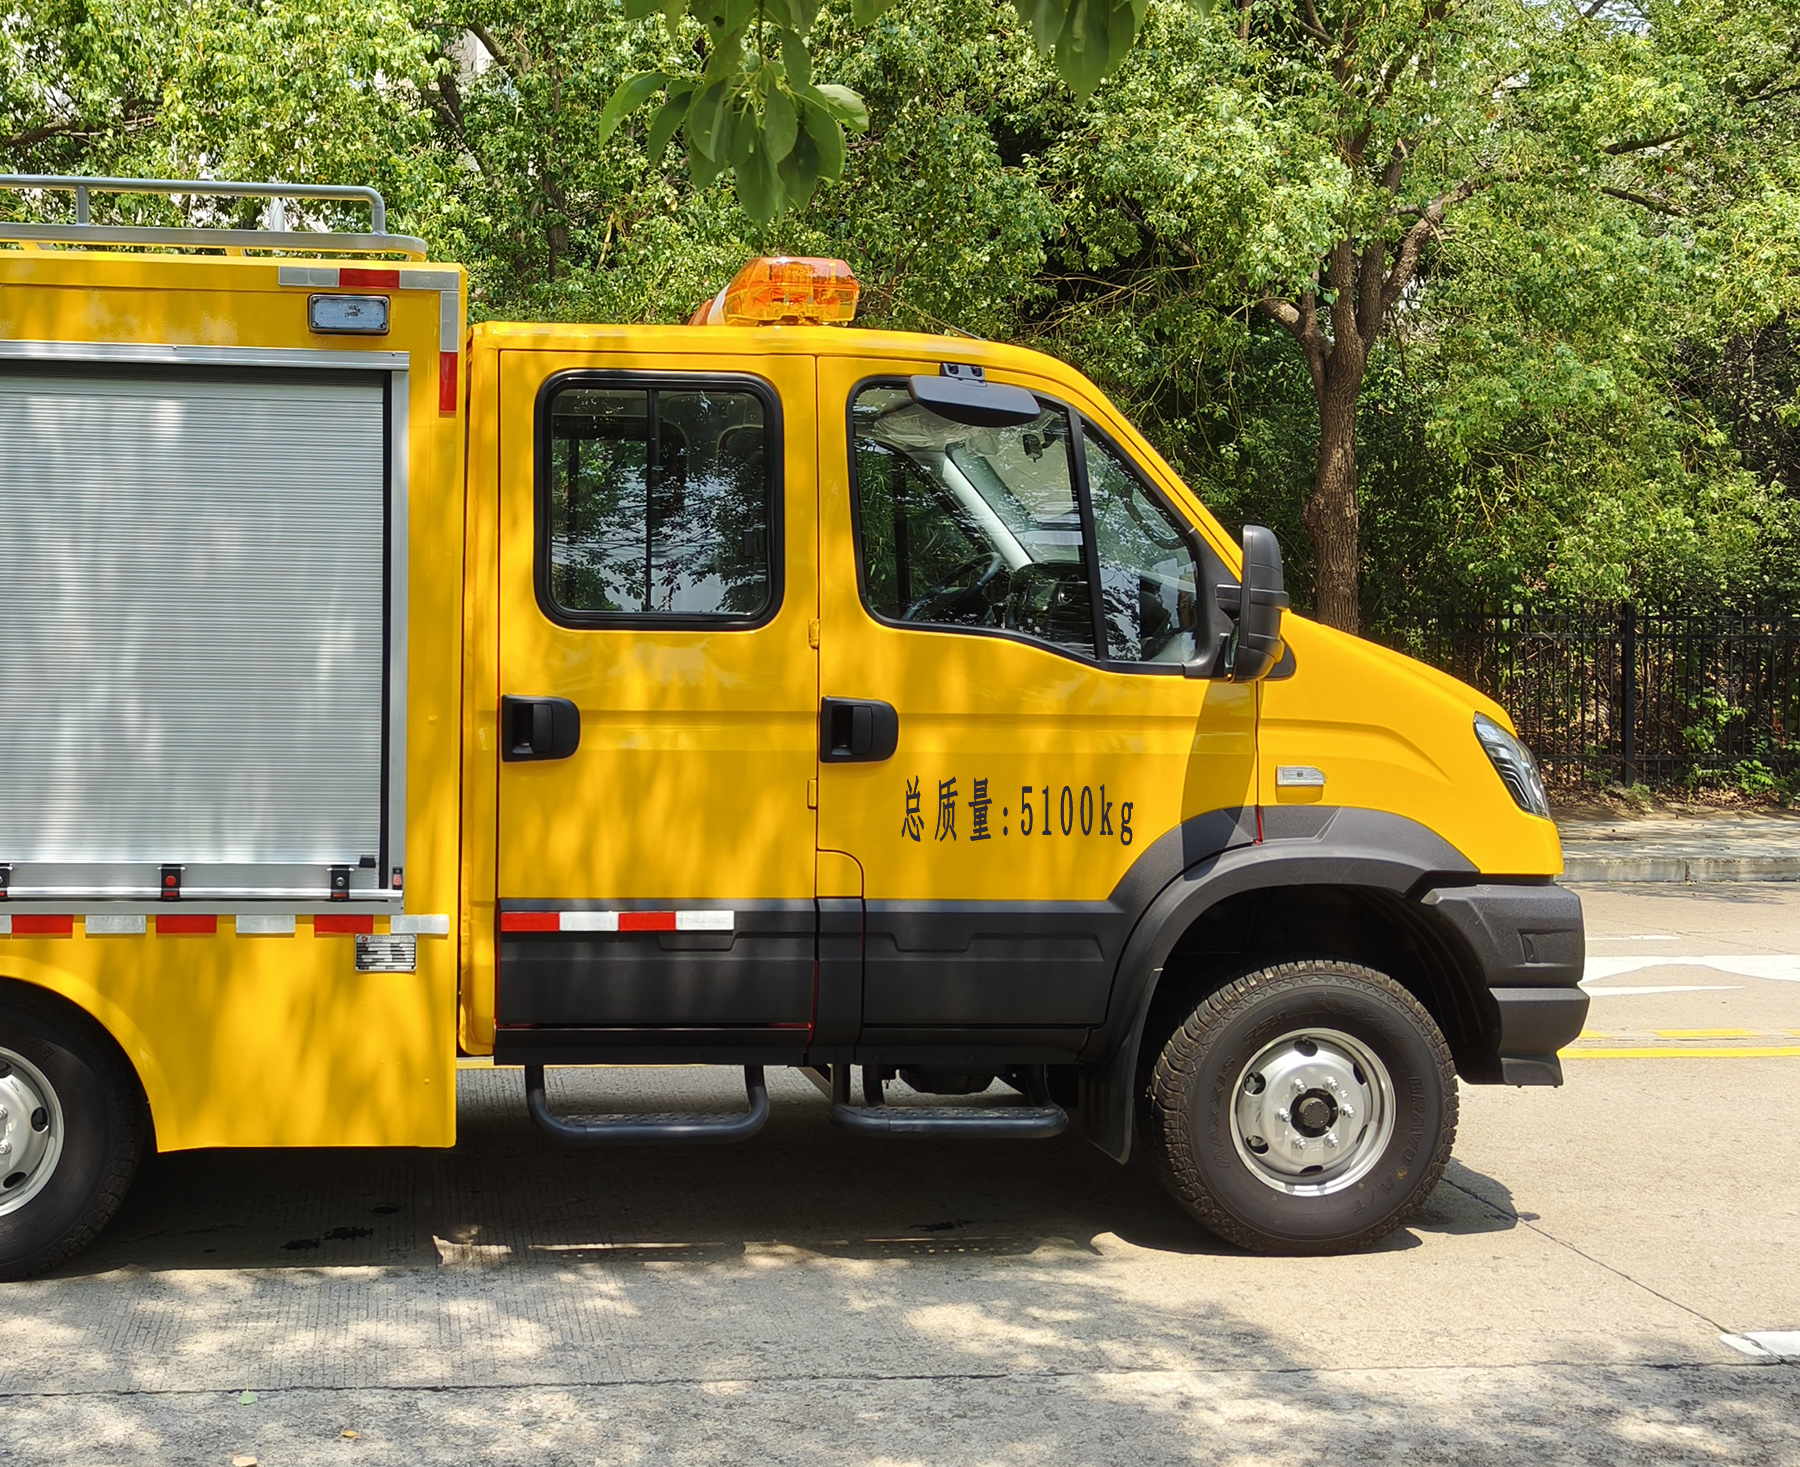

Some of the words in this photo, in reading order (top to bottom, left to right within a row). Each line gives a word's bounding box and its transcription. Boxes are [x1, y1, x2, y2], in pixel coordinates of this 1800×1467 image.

[901, 775, 1134, 846] 总质量:5100kg
[1208, 1055, 1235, 1168] MAXXIS
[1403, 1076, 1426, 1167] BRAVO
